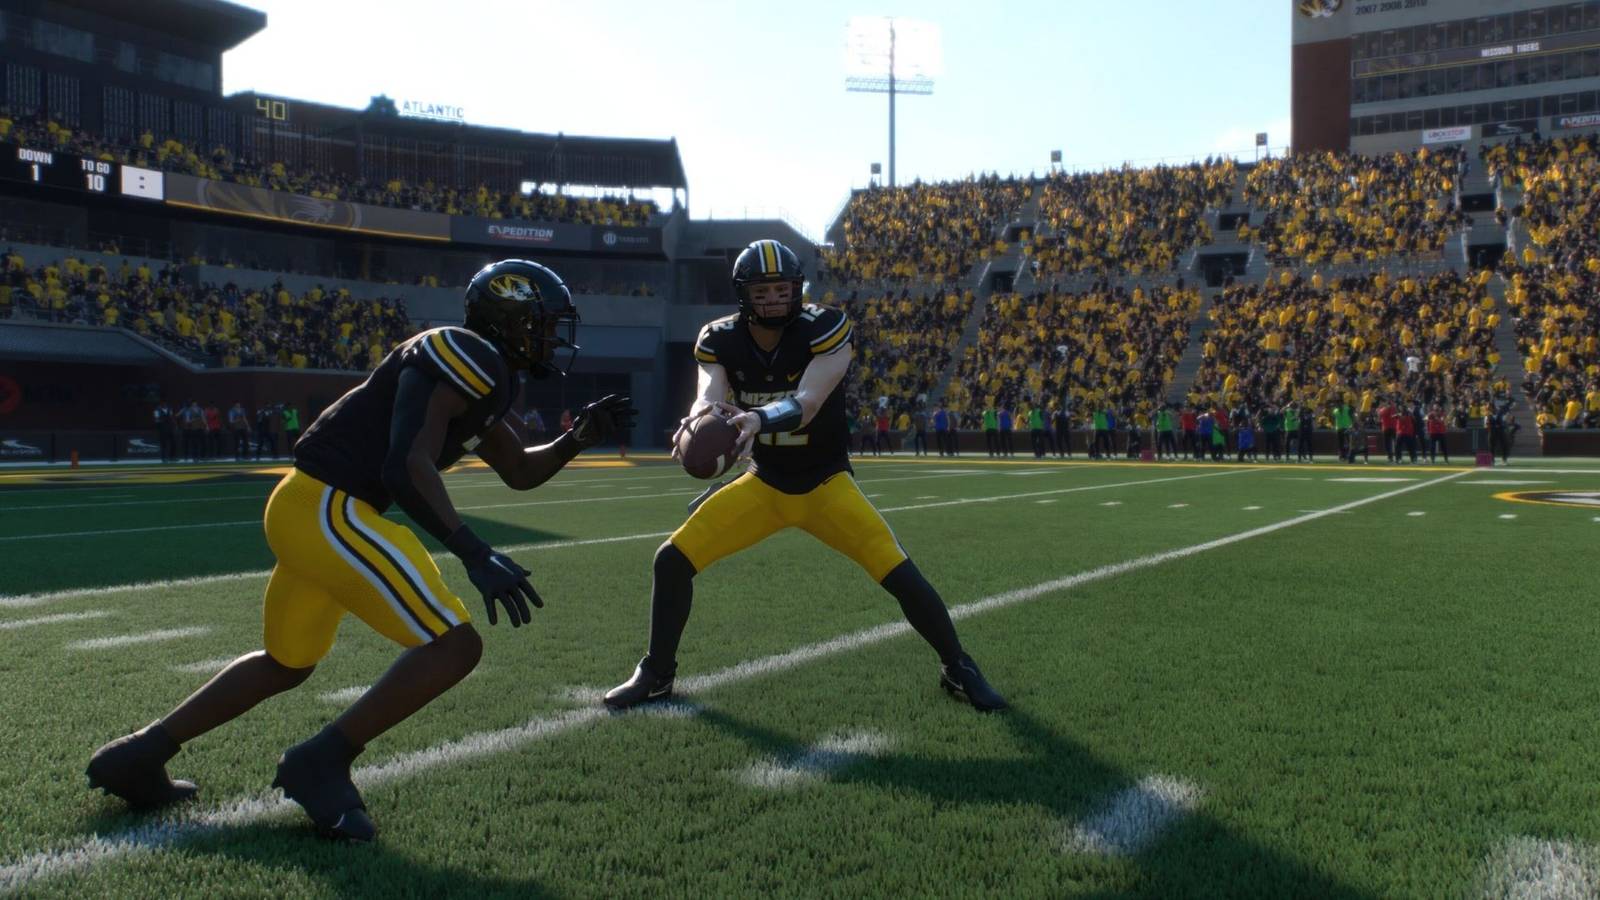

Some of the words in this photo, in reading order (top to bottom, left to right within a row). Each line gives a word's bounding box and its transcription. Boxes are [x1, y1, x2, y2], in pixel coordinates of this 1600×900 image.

[1355, 5, 1377, 16] 2007
[1517, 42, 1539, 53] TIGERS
[256, 98, 286, 120] 40
[403, 101, 465, 118] ATLANTIC
[18, 148, 52, 164] DOWN
[32, 164, 39, 181] 1
[81, 159, 94, 171] TO
[96, 161, 110, 174] GO
[86, 174, 104, 191] 10
[488, 225, 554, 238] EXPEDITION
